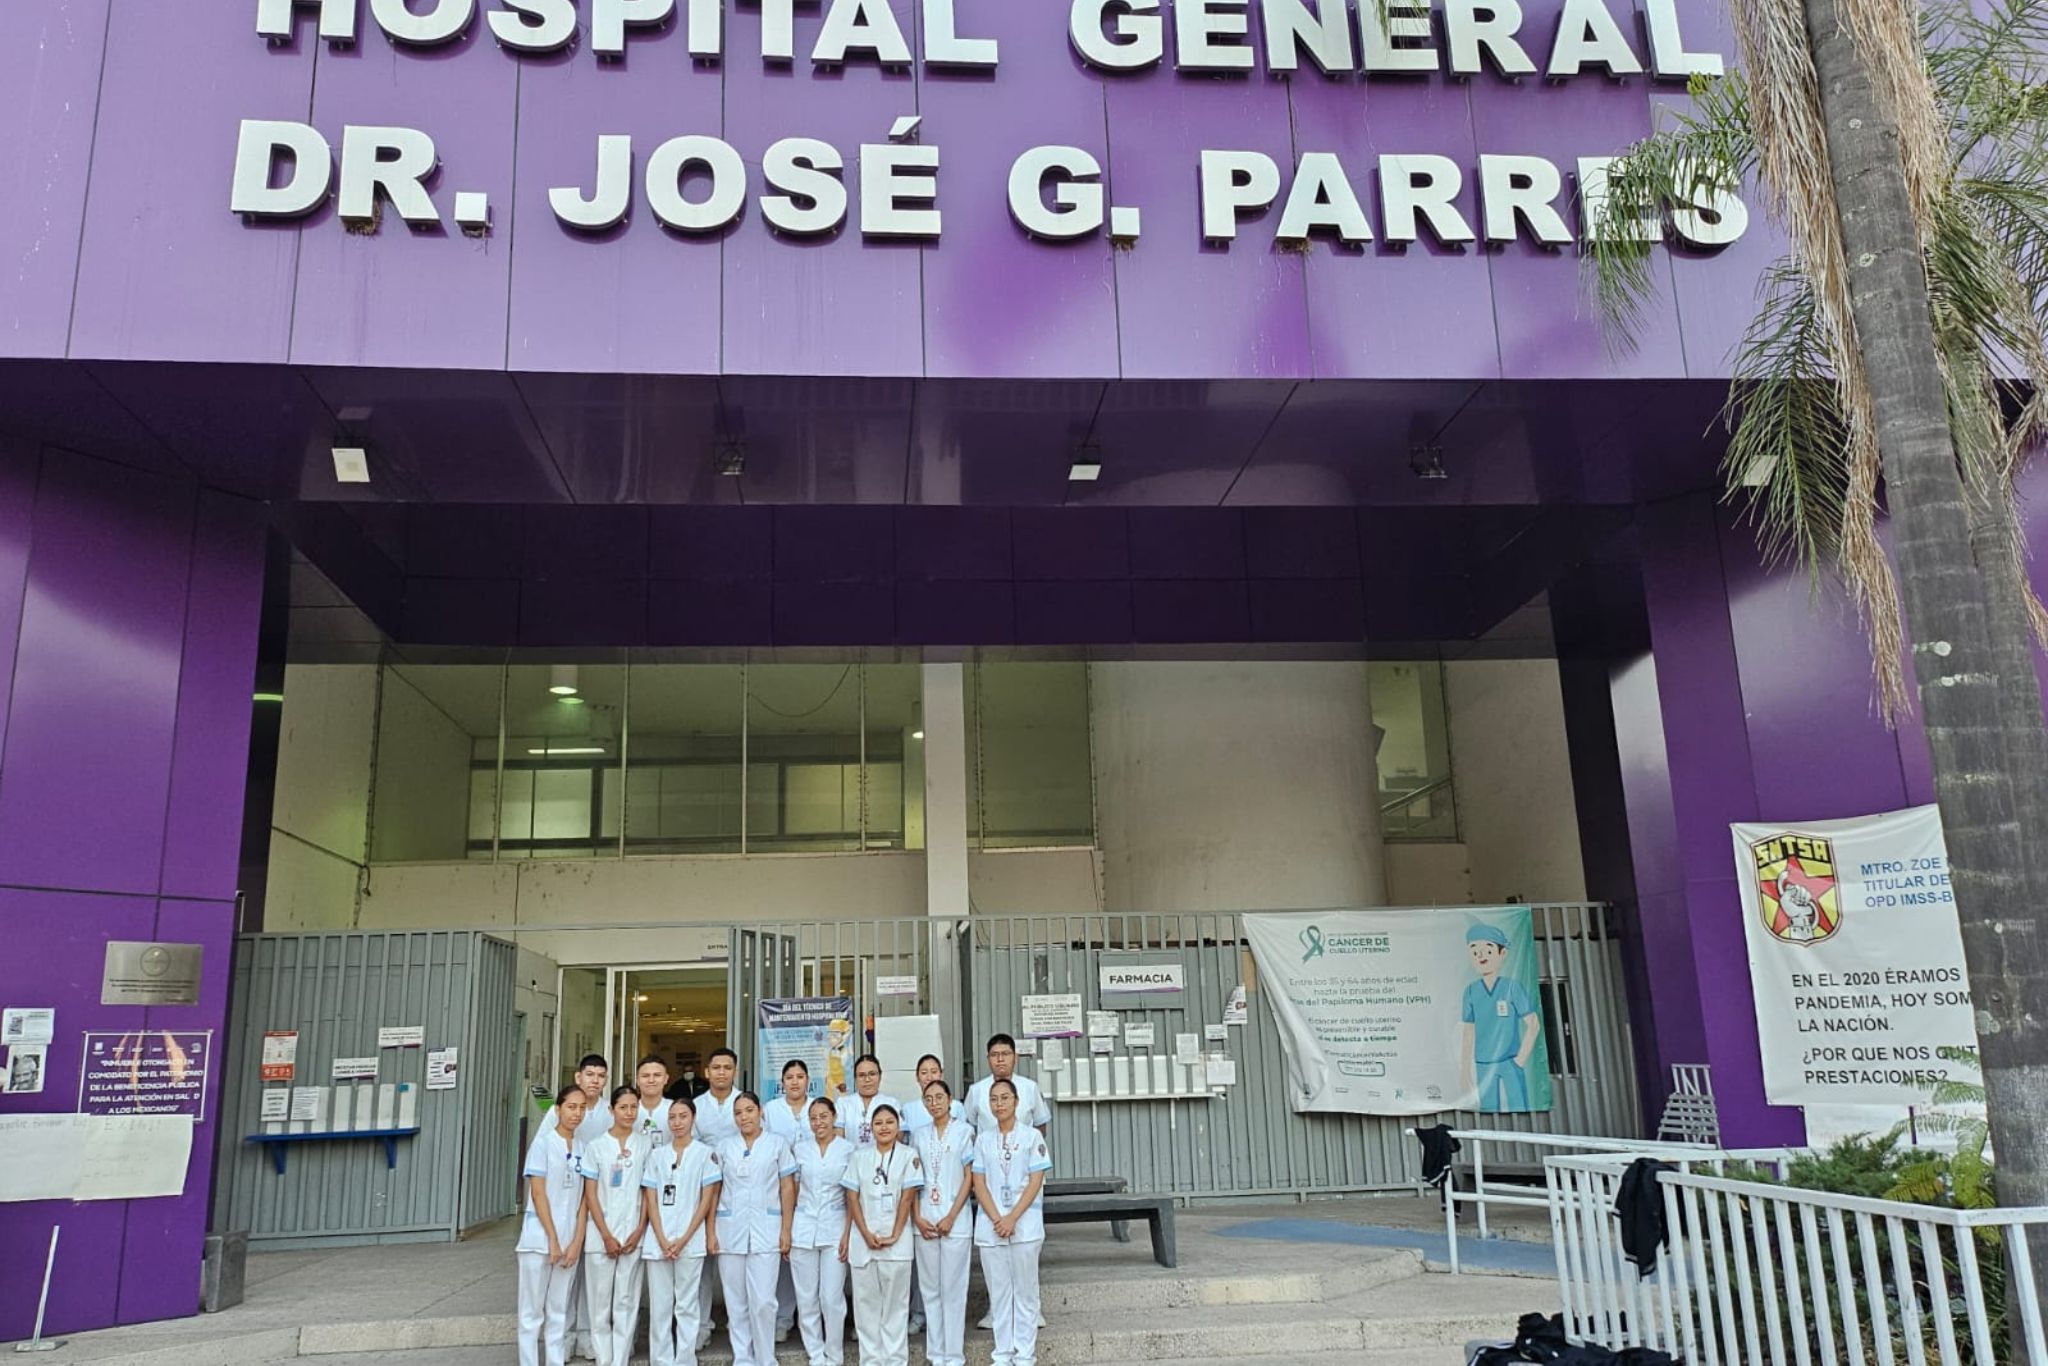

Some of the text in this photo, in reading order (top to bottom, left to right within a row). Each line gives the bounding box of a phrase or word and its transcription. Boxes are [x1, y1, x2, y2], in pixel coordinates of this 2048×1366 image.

[1068, 0, 1723, 76] GENERAL
[231, 116, 1749, 245] DR. JOSÉ G. PARRES
[1754, 836, 1829, 865] SNTSA
[1861, 857, 1941, 876] MTRO. ZOE
[1864, 877, 1928, 892] TITULAR
[1866, 896, 1896, 908] OPD
[1375, 937, 1390, 946] DE
[1359, 946, 1391, 954] UTERINO
[1109, 974, 1174, 985] FARMACIA
[1792, 967, 1961, 987] EN EL 2020 ÉRAMOS
[1322, 997, 1364, 1006] Papiloma
[1367, 996, 1404, 1005] Humano
[1406, 995, 1431, 1005] (VPH)
[1795, 994, 1887, 1010] PANDEMIA,
[1892, 993, 1928, 1007] HOY
[1798, 1014, 1894, 1032] LA NACIÓN.
[1803, 1047, 1847, 1065] ¿POR
[1852, 1047, 1888, 1061] QUE
[1893, 1046, 1930, 1060] NOS
[1805, 1069, 1948, 1085] PRESTACIONES?
[116, 1106, 131, 1114] LOS
